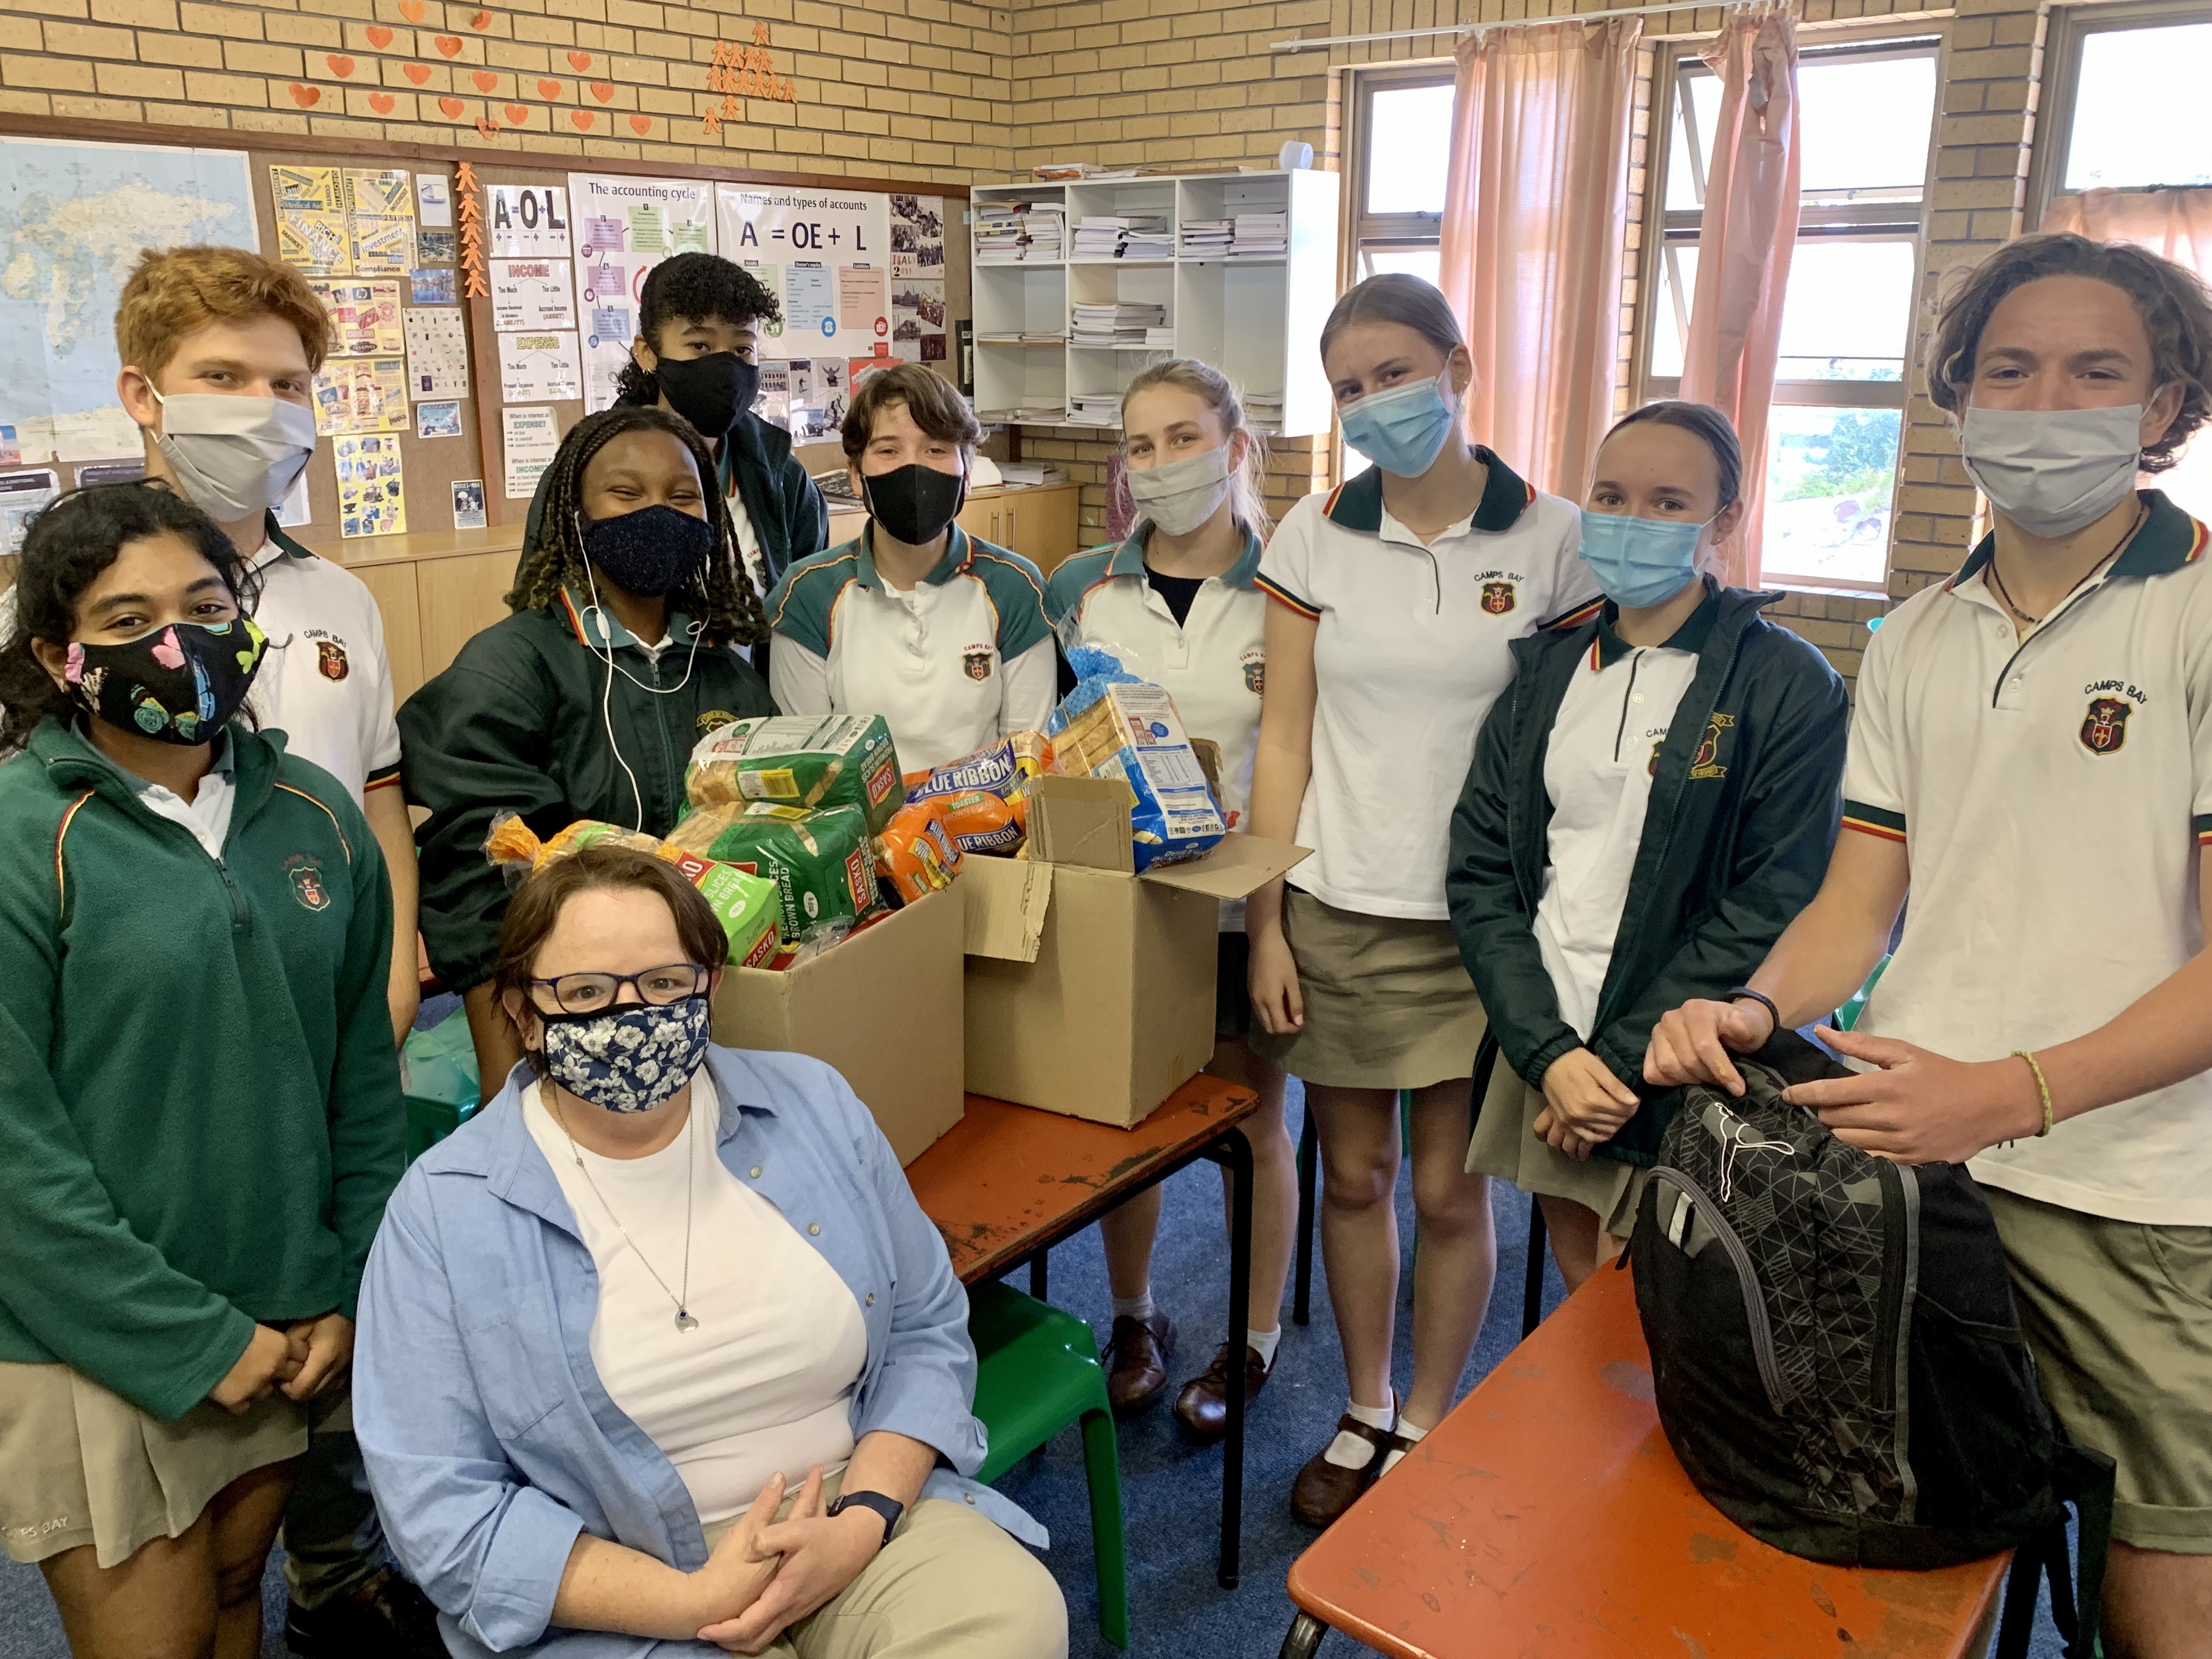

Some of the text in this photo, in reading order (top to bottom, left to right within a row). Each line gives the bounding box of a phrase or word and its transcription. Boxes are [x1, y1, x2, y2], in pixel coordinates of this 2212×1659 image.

[281, 184, 302, 197] Rand
[332, 171, 342, 208] GROWTH
[390, 188, 408, 211] INTEREST
[589, 183, 695, 201] The accounting cycle
[346, 178, 358, 237] DEVELOPMENT
[740, 193, 867, 211] Names and types of accounts
[281, 230, 304, 250] MARKET
[289, 214, 345, 265] FINANCE
[315, 221, 336, 242] RICH
[740, 220, 759, 247] A
[792, 222, 823, 249] OE
[857, 225, 867, 250] L
[508, 264, 550, 277] INCOME
[347, 330, 374, 338] DRUM
[516, 337, 560, 350] EXPENSE
[514, 421, 546, 429] EXPENSE?
[1474, 571, 1524, 582] CAMPS BAY
[304, 629, 347, 648] CAMPS BAY
[964, 643, 983, 651] CAMPS
[1239, 652, 1259, 661] CAMPS
[2085, 680, 2147, 704] CAMPS BAY
[1646, 728, 1666, 738] CAM
[873, 737, 889, 758] BROWN
[875, 744, 893, 768] PREMIUM
[860, 752, 875, 772] BREAD
[953, 754, 1011, 787] RIBBON
[861, 764, 876, 783] SLICES
[872, 768, 892, 799] SASKO
[942, 799, 995, 822] BROWN BREAD
[951, 795, 980, 810] TOASTER
[929, 821, 942, 842] BLUE
[940, 836, 958, 863] RIBBON
[957, 826, 1019, 851] UE RIBBON
[915, 841, 929, 863] WIN
[704, 869, 732, 899] SLICES
[851, 858, 866, 904] SASKO
[781, 867, 800, 939] BROWN BREAD
[747, 931, 774, 968] SASKO
[42, 1517, 68, 1535] BAY
